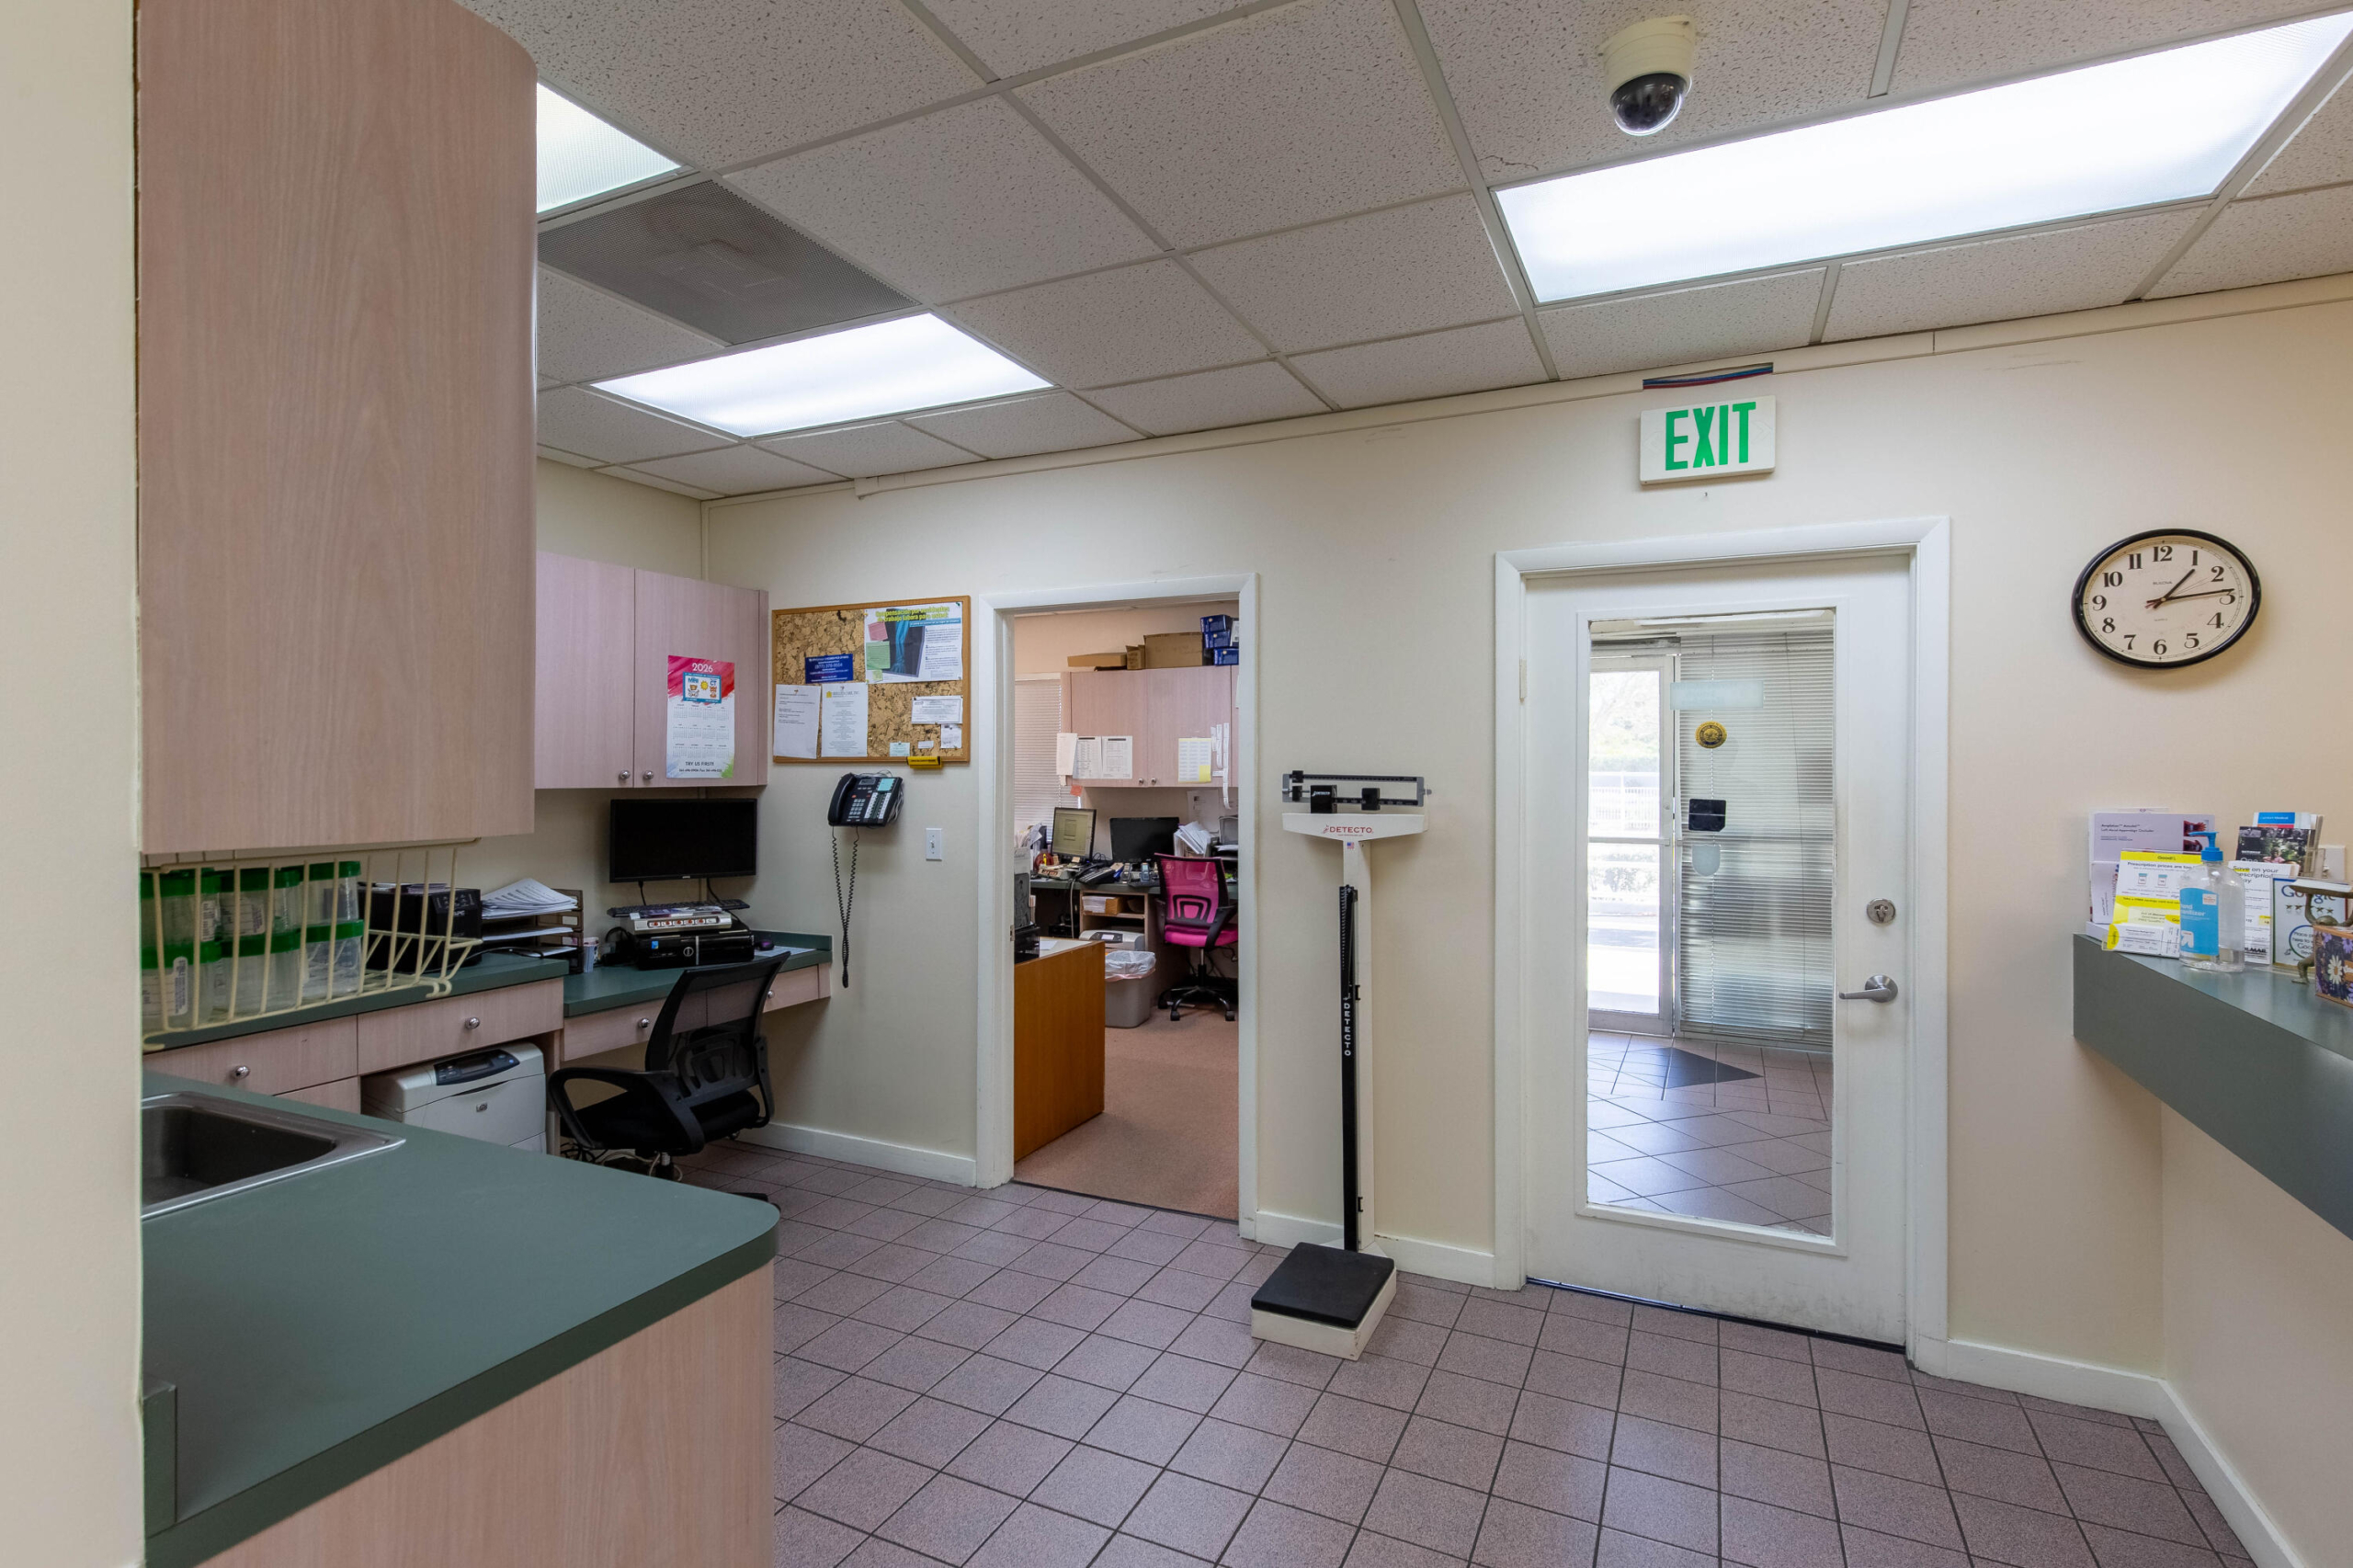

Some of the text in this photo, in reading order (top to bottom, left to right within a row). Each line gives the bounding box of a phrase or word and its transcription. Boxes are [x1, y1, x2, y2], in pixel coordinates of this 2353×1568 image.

[1665, 401, 1756, 471] EXIT
[2128, 553, 2143, 570] 11
[2152, 545, 2173, 562] 12
[2191, 550, 2198, 566] 1
[2102, 572, 2123, 587] 10
[2211, 566, 2224, 582] 2
[2092, 595, 2107, 611] 9
[2219, 589, 2236, 605] 3
[2102, 618, 2116, 633] 8
[2207, 612, 2224, 629] 4
[2124, 634, 2137, 650] 7
[2153, 639, 2167, 654] 6
[2184, 632, 2200, 649] 5
[692, 663, 714, 673] 2026
